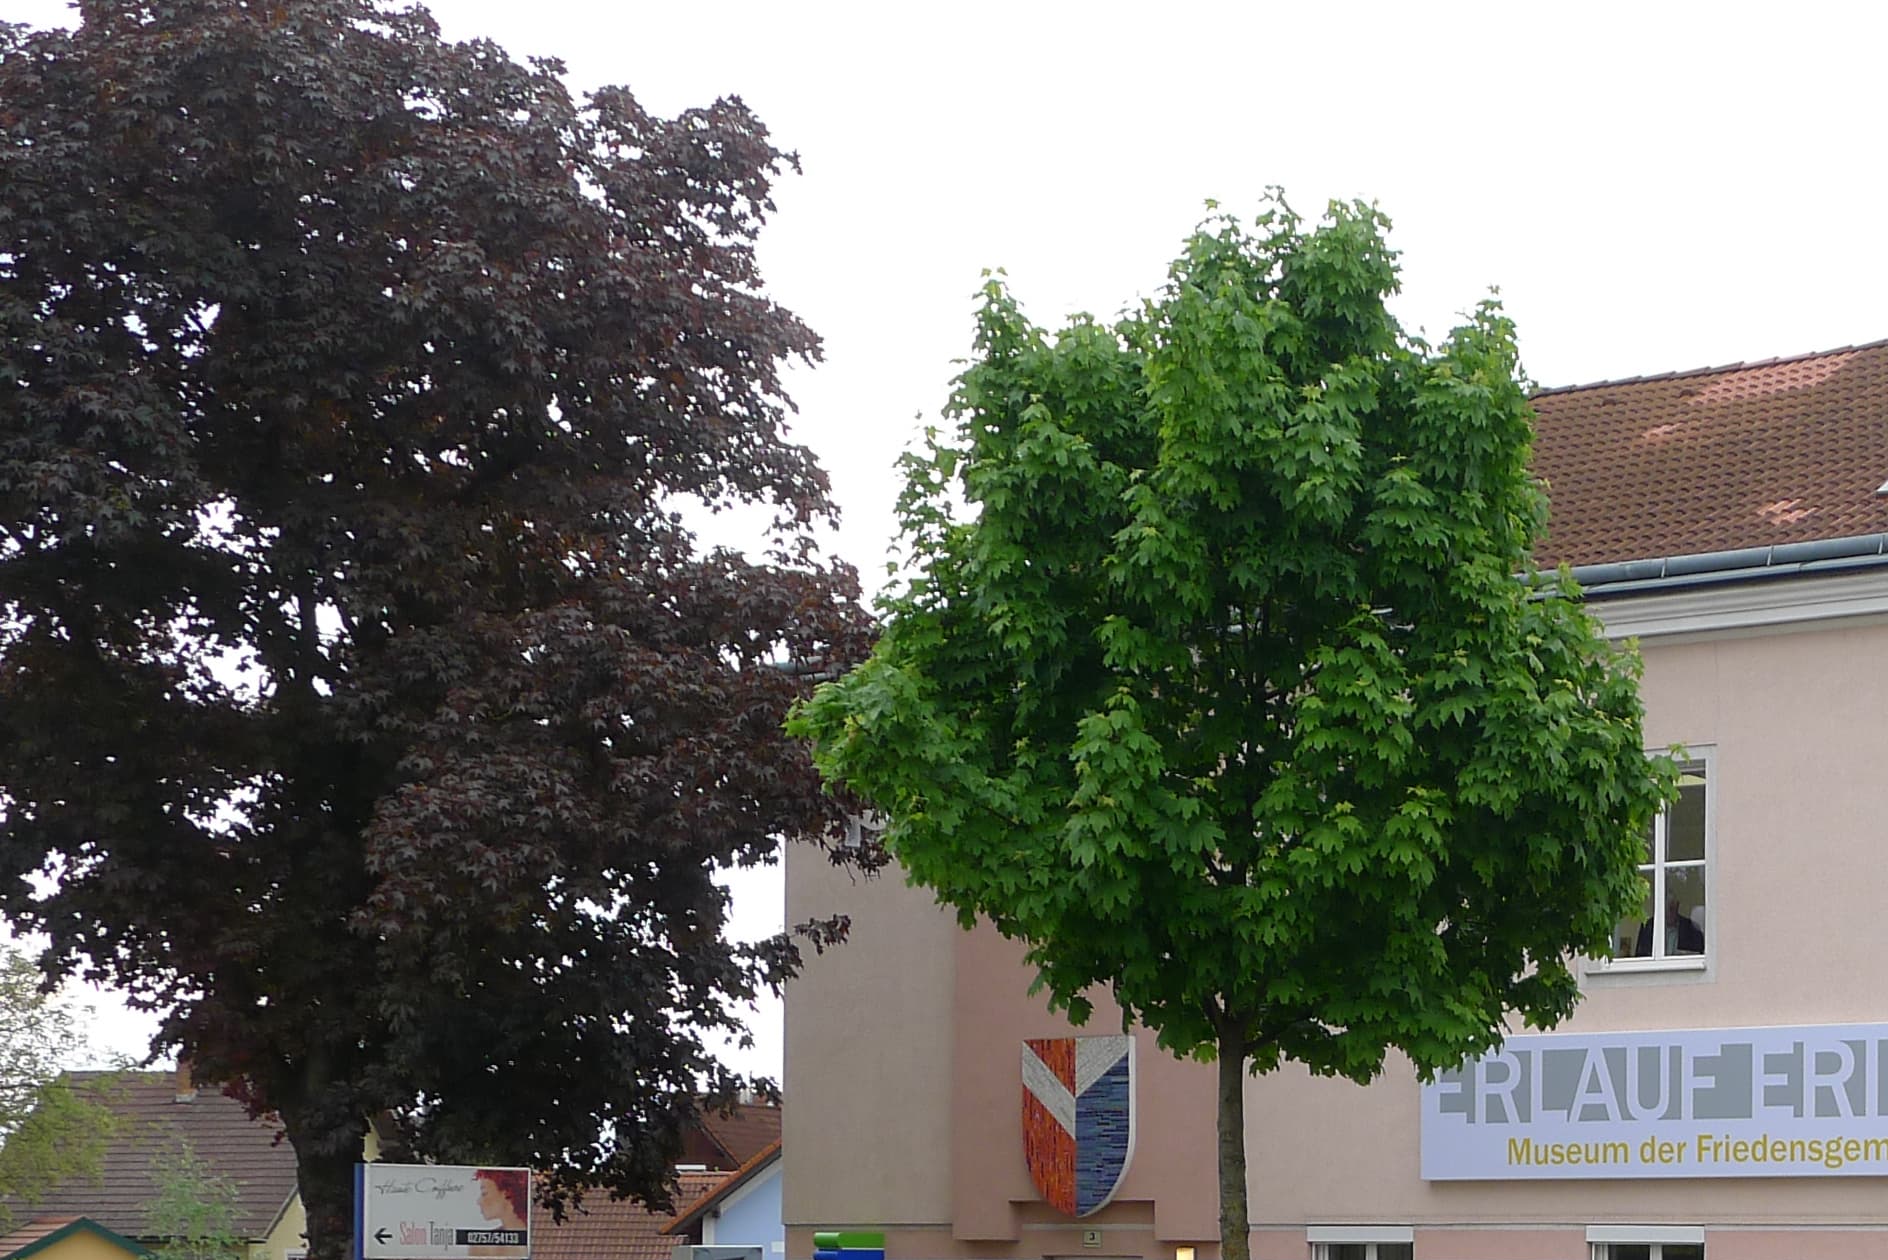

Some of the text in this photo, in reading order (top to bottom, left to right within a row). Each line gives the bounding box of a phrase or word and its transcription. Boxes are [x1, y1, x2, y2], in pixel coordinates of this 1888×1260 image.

[1430, 1044, 1745, 1124] ERLAUF
[1507, 1137, 1630, 1166] Museum
[1639, 1135, 1687, 1164] der
[399, 1221, 427, 1246] Salon
[428, 1220, 454, 1250] Tanja
